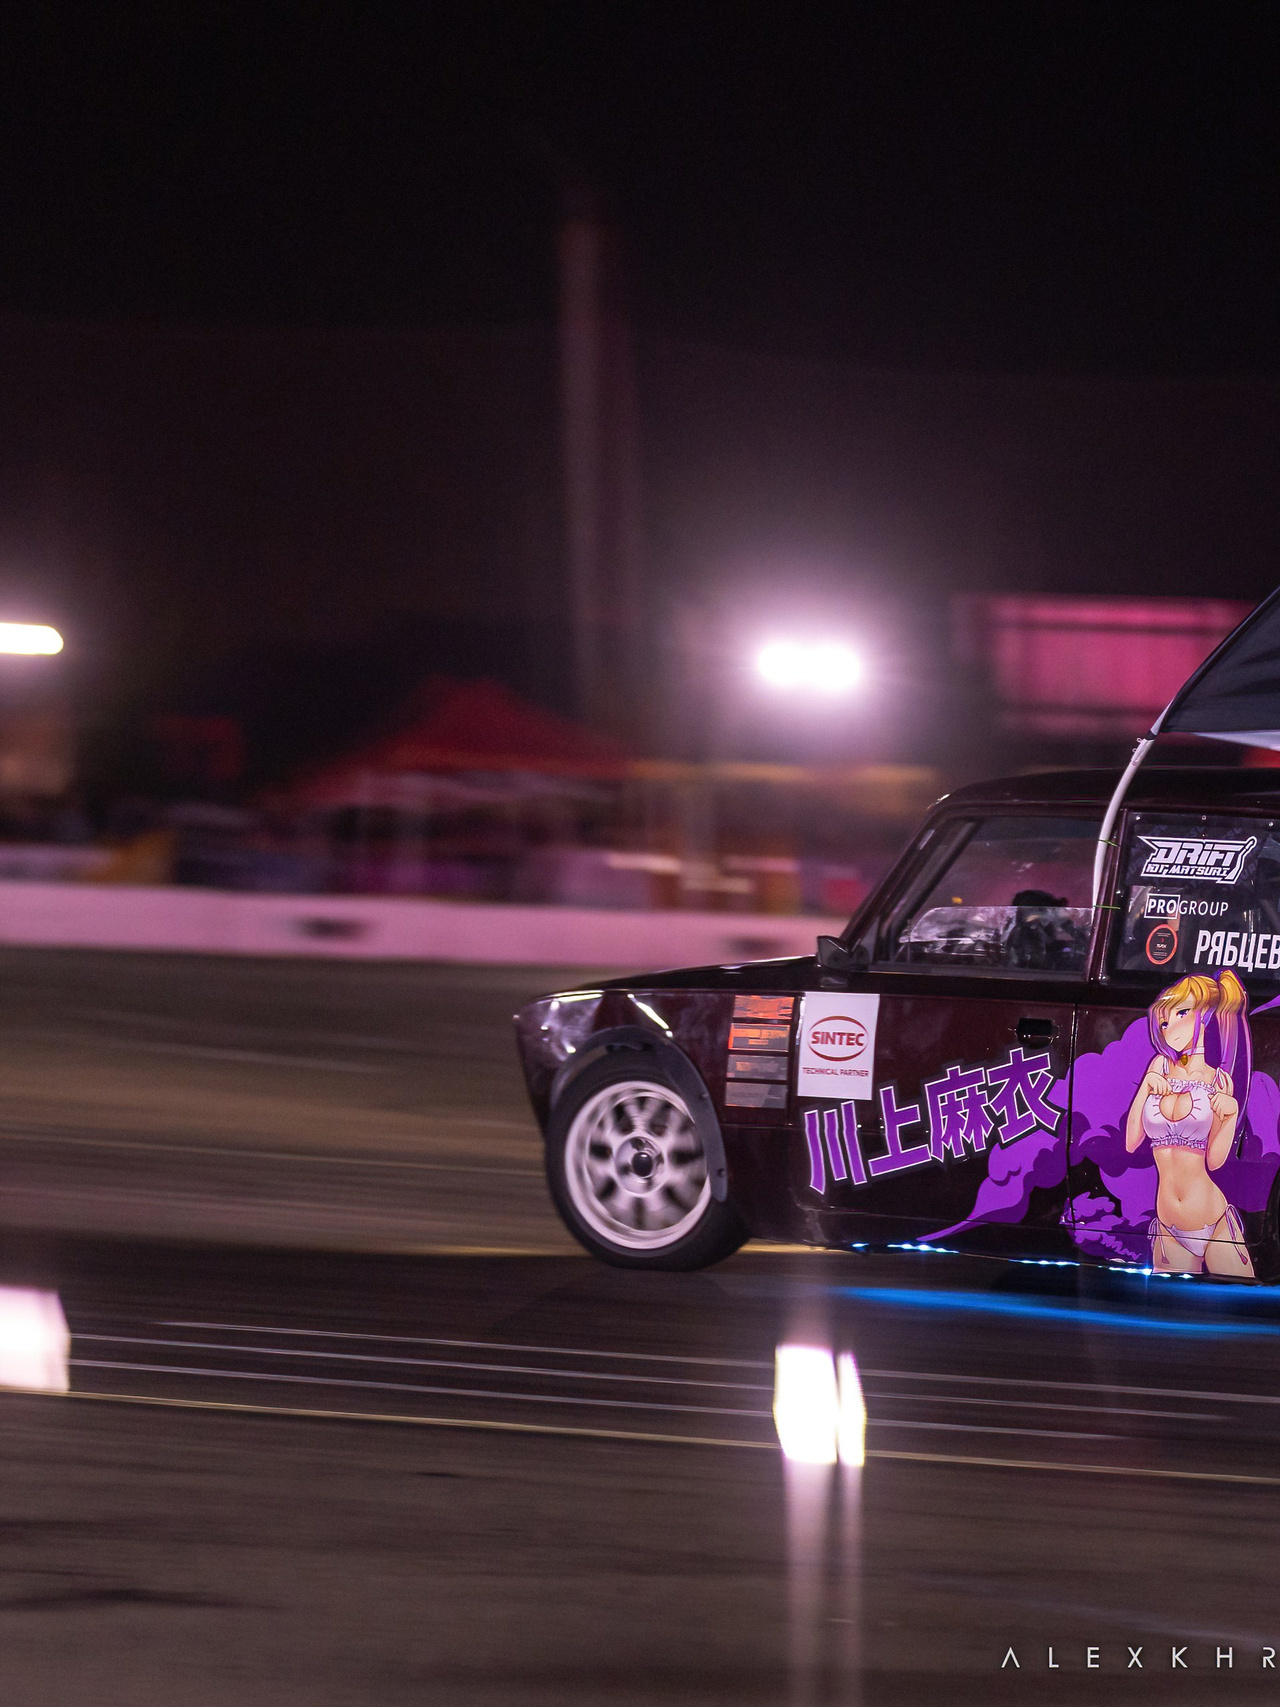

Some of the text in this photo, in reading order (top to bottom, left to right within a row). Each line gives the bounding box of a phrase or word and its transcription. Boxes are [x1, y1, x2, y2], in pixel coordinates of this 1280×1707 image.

[811, 1031, 865, 1046] SINTEC
[802, 1067, 869, 1077] TECHNICAL PARTNER
[804, 1047, 1061, 1195] 川上麻衣
